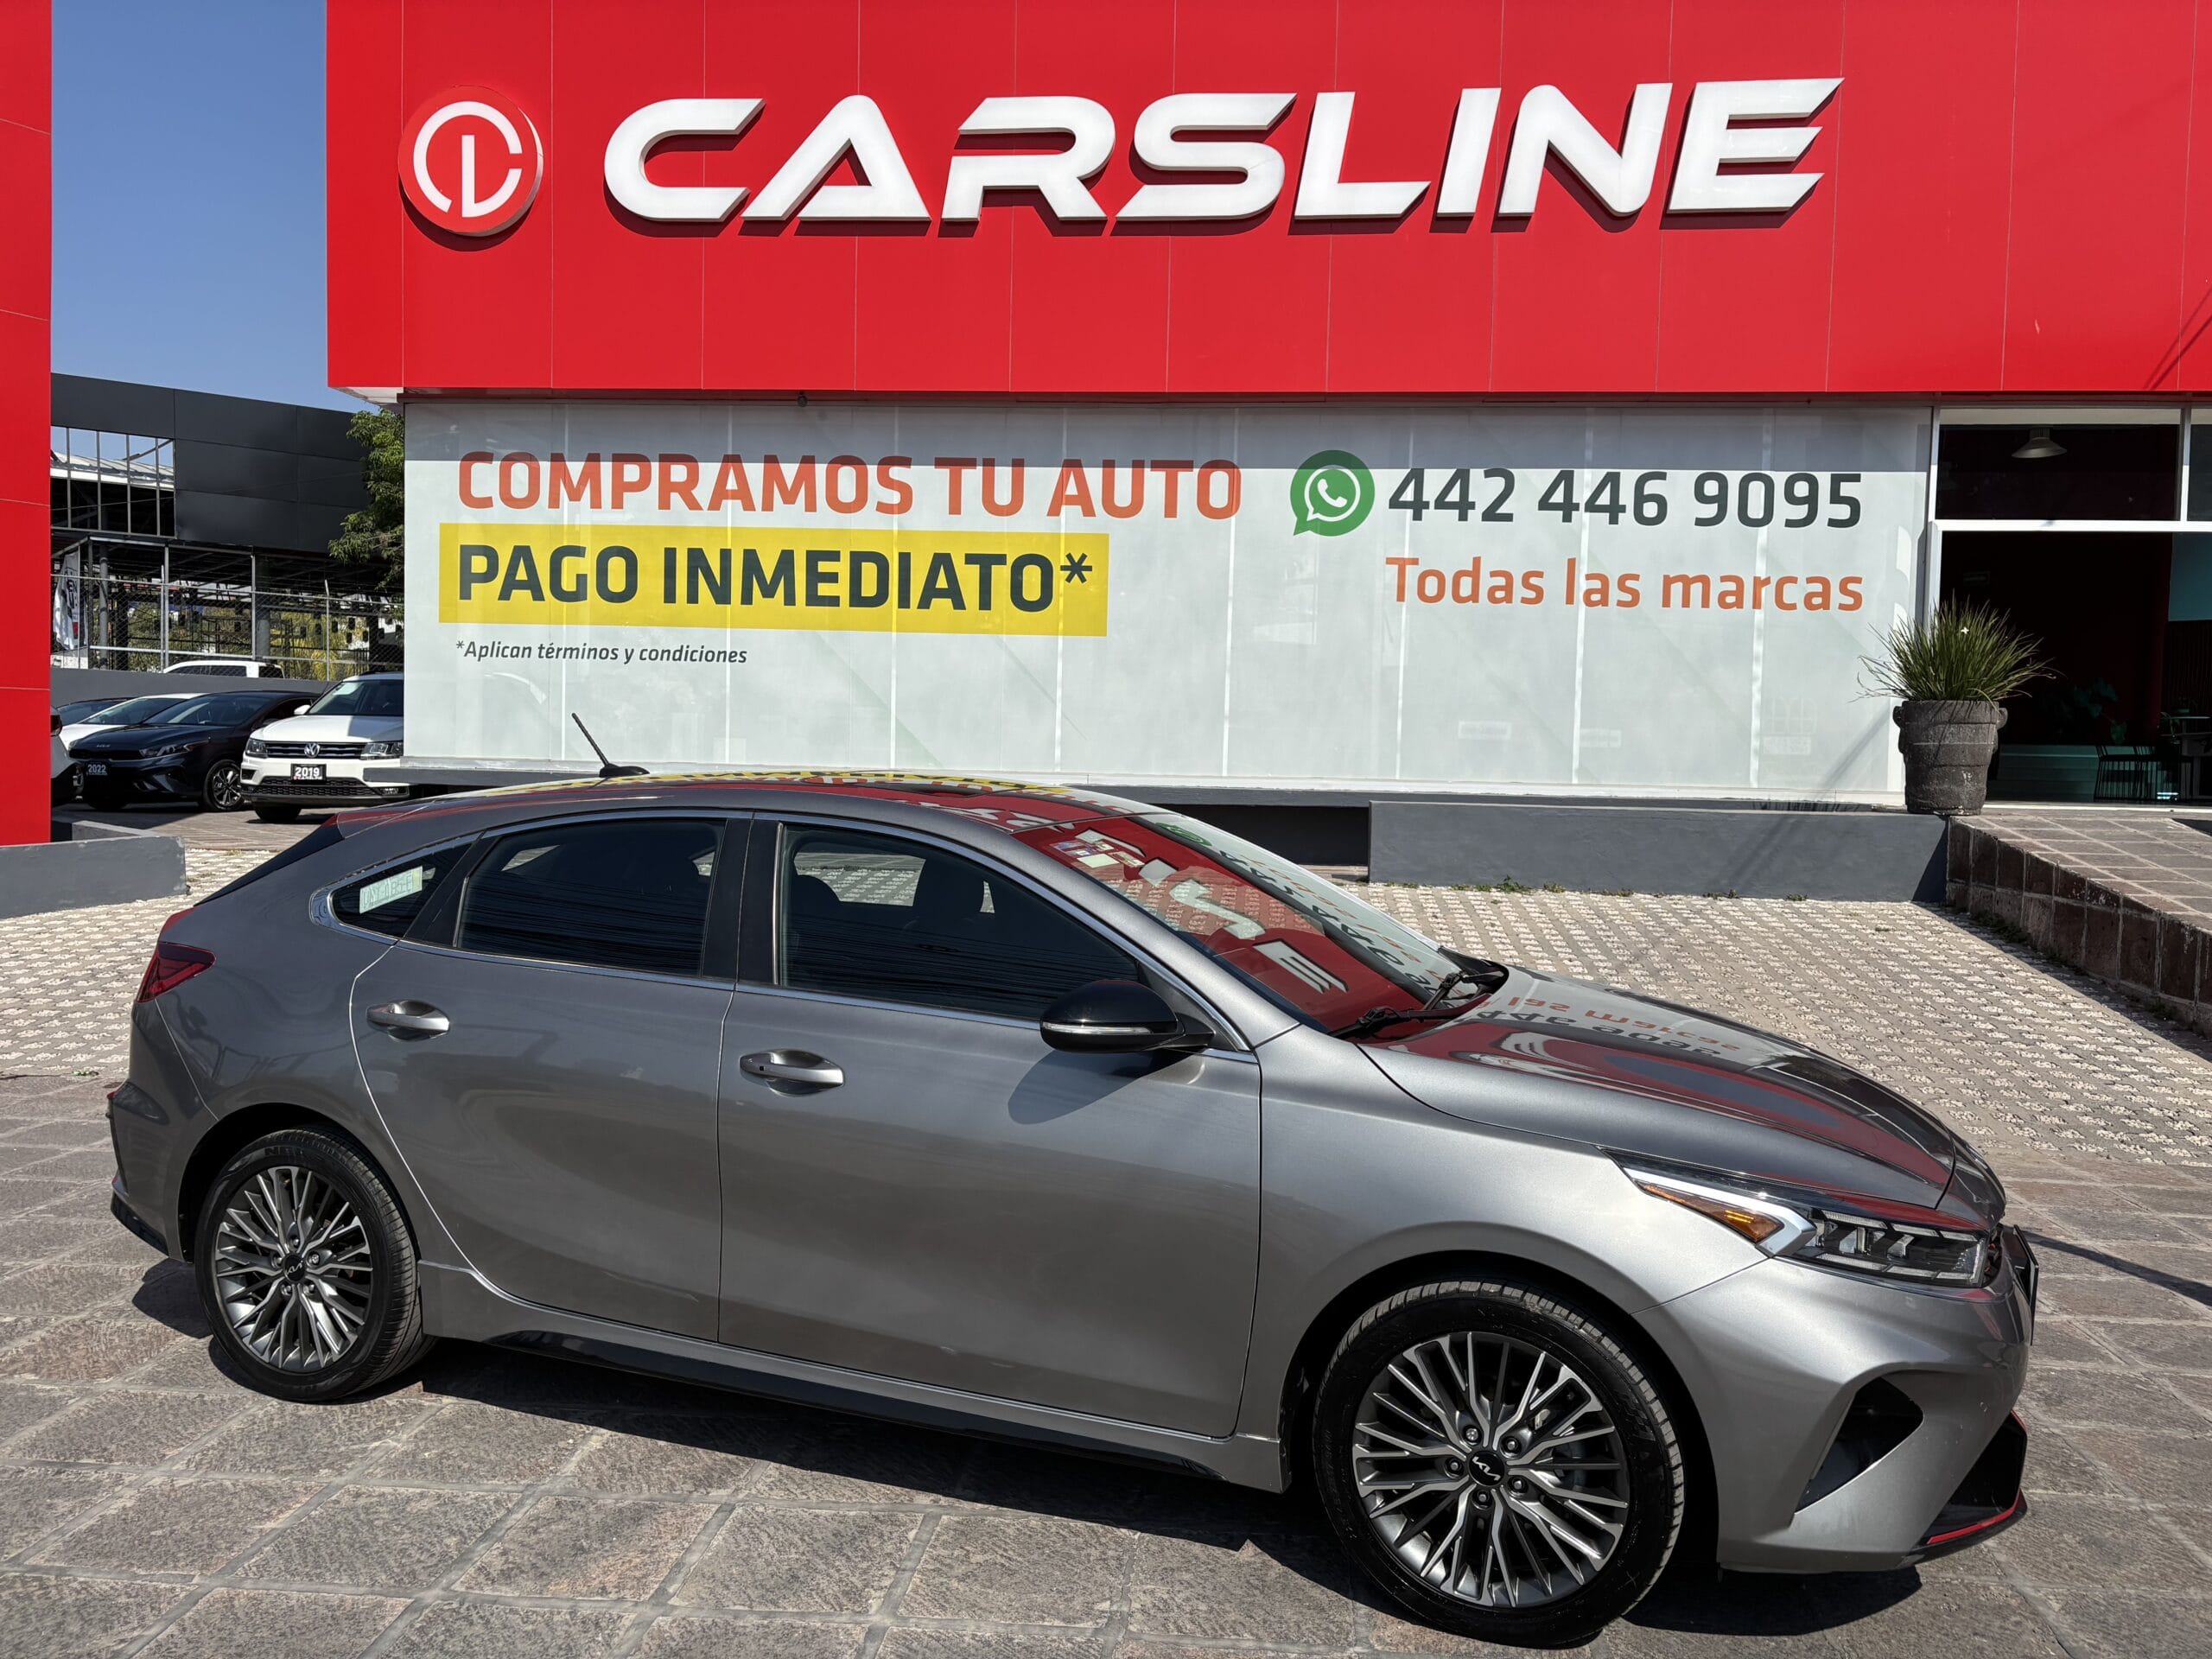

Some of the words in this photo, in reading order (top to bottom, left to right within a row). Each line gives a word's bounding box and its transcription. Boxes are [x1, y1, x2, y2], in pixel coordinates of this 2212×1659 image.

[604, 77, 1845, 225] CARSLINE
[459, 451, 913, 516] COMPRAMOS
[936, 456, 1025, 518] TU
[1046, 459, 1243, 521] AUTO
[1389, 467, 1516, 523] 442
[1538, 469, 1669, 526] 446
[1693, 472, 1862, 529] 9095
[459, 543, 639, 604] PAGO
[1385, 556, 1545, 606] Todas
[1566, 558, 1641, 608] las
[1662, 574, 1864, 612] marcas
[537, 641, 620, 661] términos
[623, 645, 635, 664] y
[639, 643, 748, 664] condiciones
[87, 764, 107, 774] 2022
[294, 766, 321, 779] 2019
